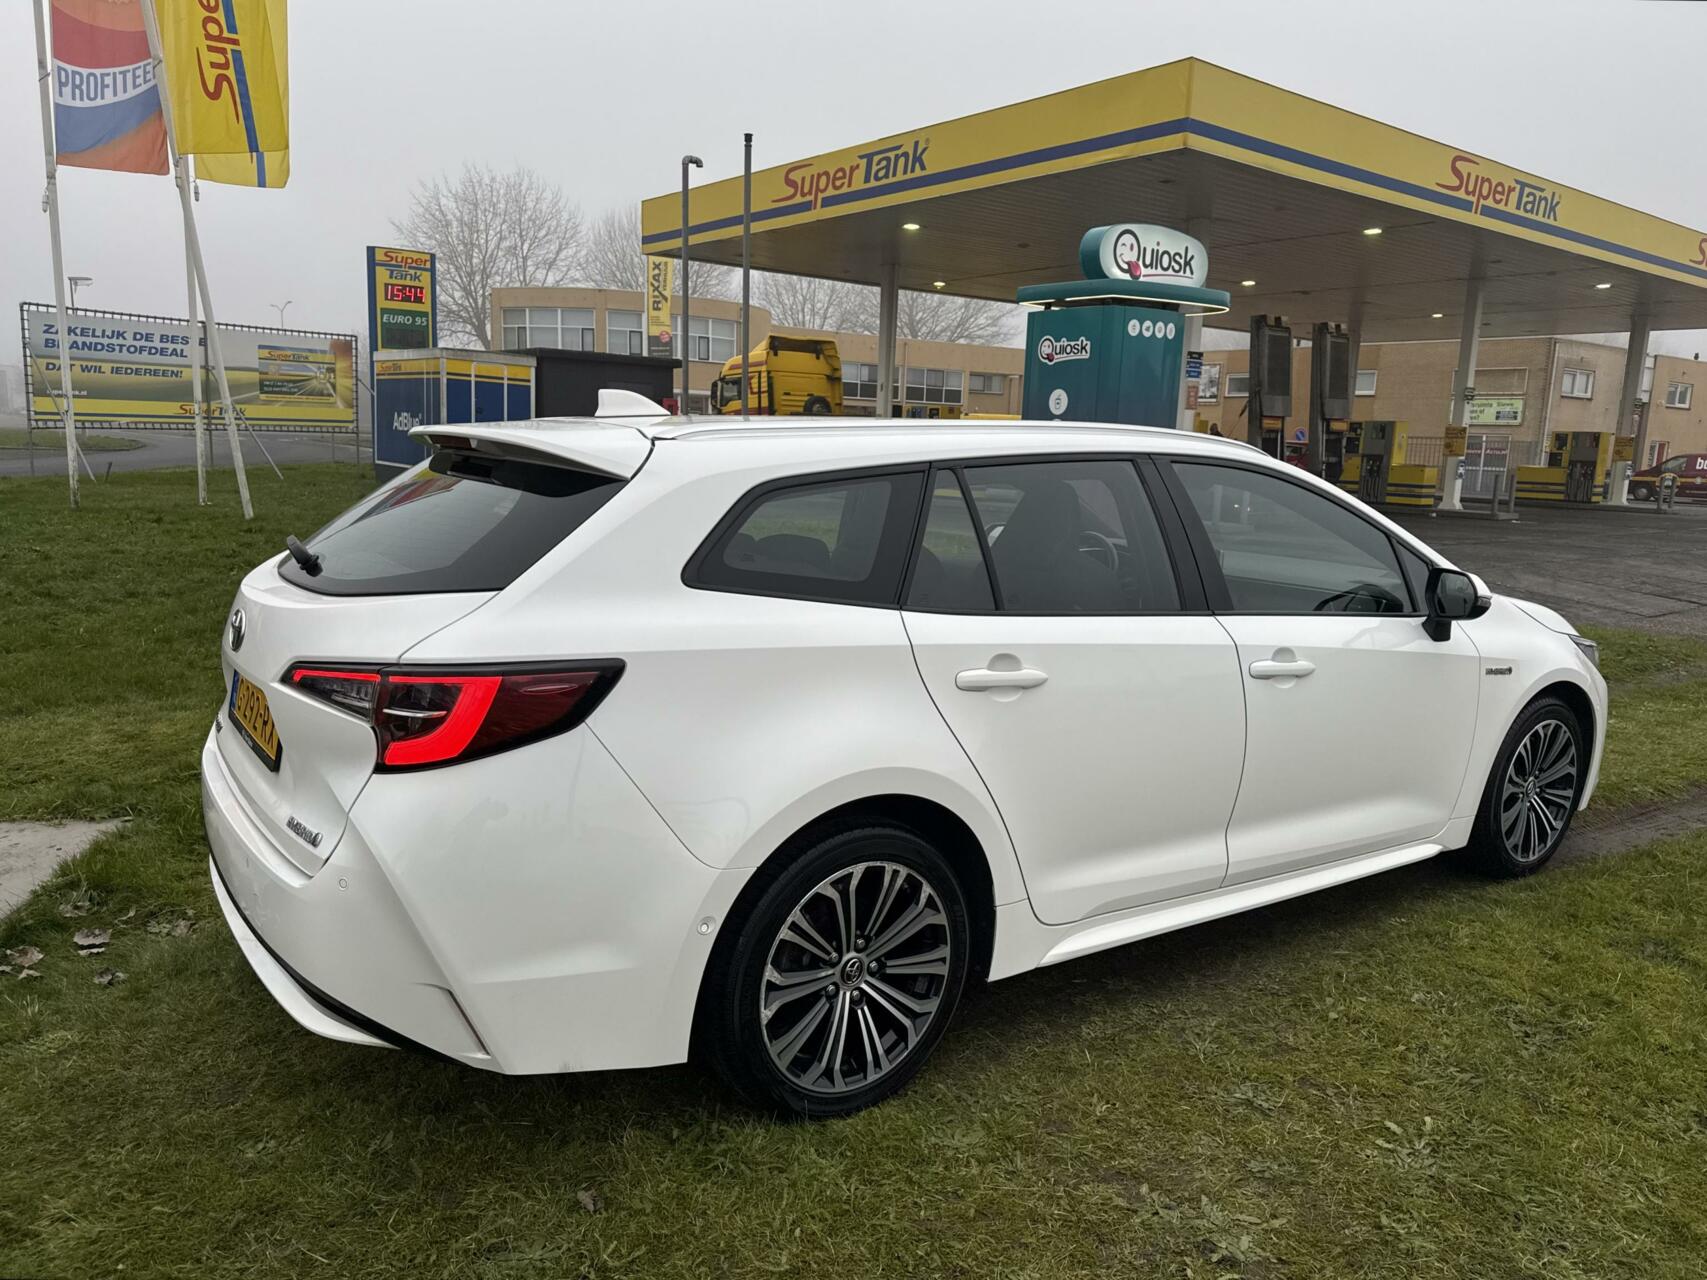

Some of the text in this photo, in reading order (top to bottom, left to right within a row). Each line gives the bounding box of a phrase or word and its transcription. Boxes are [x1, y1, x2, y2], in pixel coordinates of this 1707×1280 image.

[57, 62, 156, 101] PROFITEE
[771, 140, 929, 210] SuperTank
[1435, 155, 1560, 221] SuperTank
[382, 251, 430, 269] Super
[1113, 229, 1194, 279] Quiosk
[384, 269, 422, 282] Tank
[387, 285, 425, 302] 15:44
[383, 314, 427, 326] EURO 95
[132, 331, 154, 343] DE
[159, 333, 207, 347] BESE
[1040, 338, 1088, 362] Quiosk
[80, 364, 105, 375] WIL
[110, 366, 183, 378] IEDEREEN!
